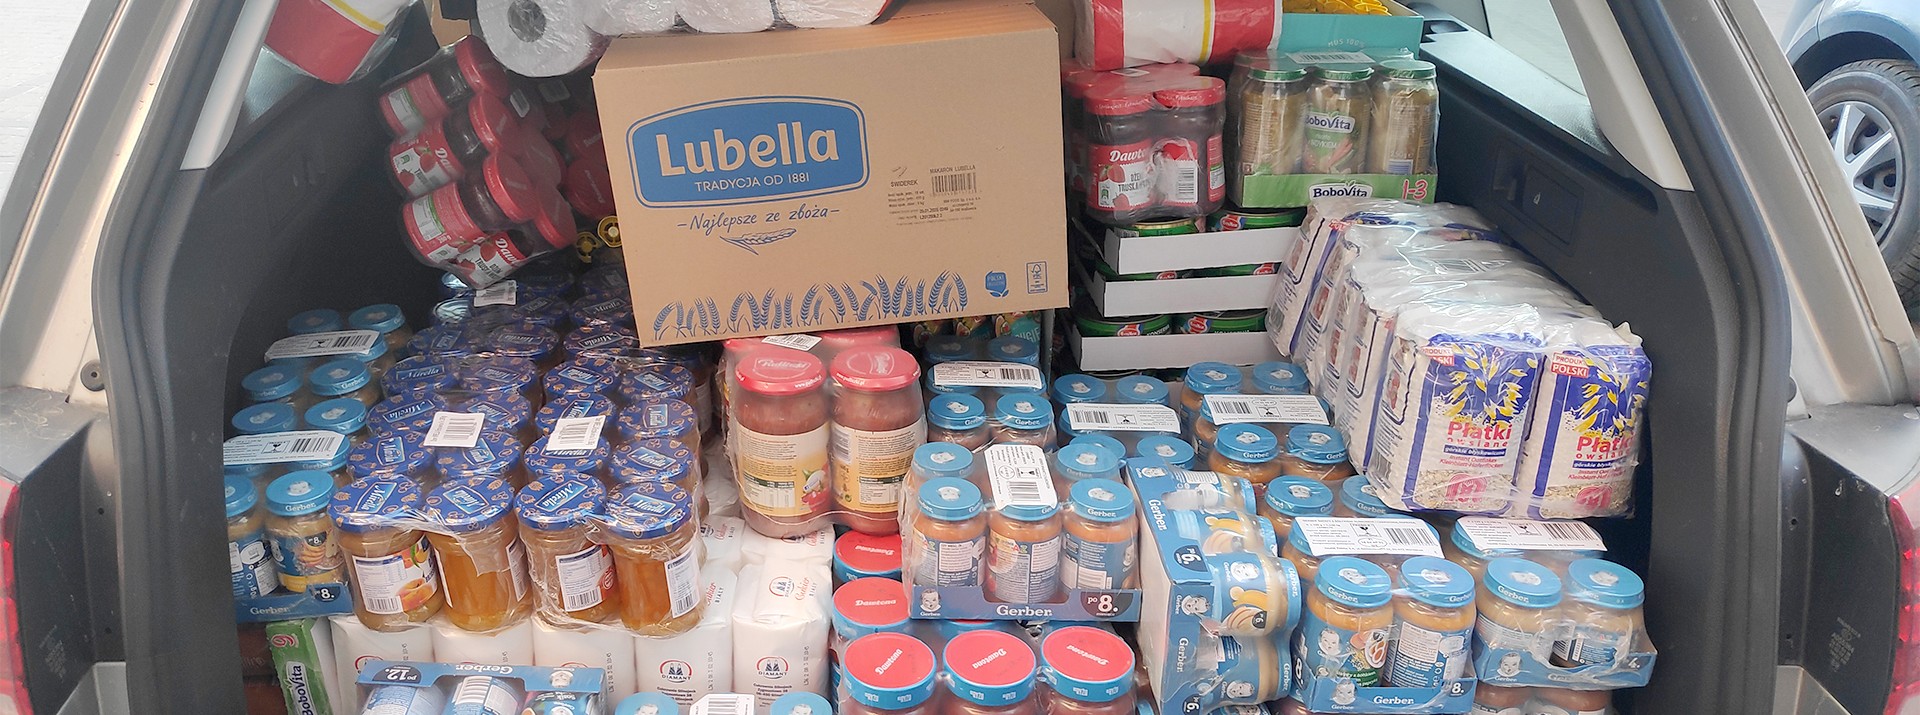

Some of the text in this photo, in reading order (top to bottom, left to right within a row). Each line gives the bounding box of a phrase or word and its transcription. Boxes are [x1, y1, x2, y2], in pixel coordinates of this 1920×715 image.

[655, 121, 839, 177] Lubella
[695, 173, 810, 192] TRADYCJA OD 1881
[1313, 185, 1368, 198] BoboVita
[1402, 179, 1428, 200] 1-3
[690, 204, 828, 236] Najlepsze ze zboża
[593, 300, 622, 314] Mirella
[584, 332, 618, 346] Mirella
[1552, 364, 1588, 377] POLSKI
[388, 401, 428, 418] Mirella
[1447, 421, 1513, 441] Płatki
[361, 483, 388, 511] Mirella
[542, 482, 575, 508] Mirella
[854, 598, 897, 608] Dawtona
[1088, 595, 1119, 612] po 8.
[874, 648, 904, 676] Dawtona
[972, 647, 1008, 669] Dawtona
[1066, 643, 1110, 666] Dawtona
[1451, 683, 1465, 694] 8.
